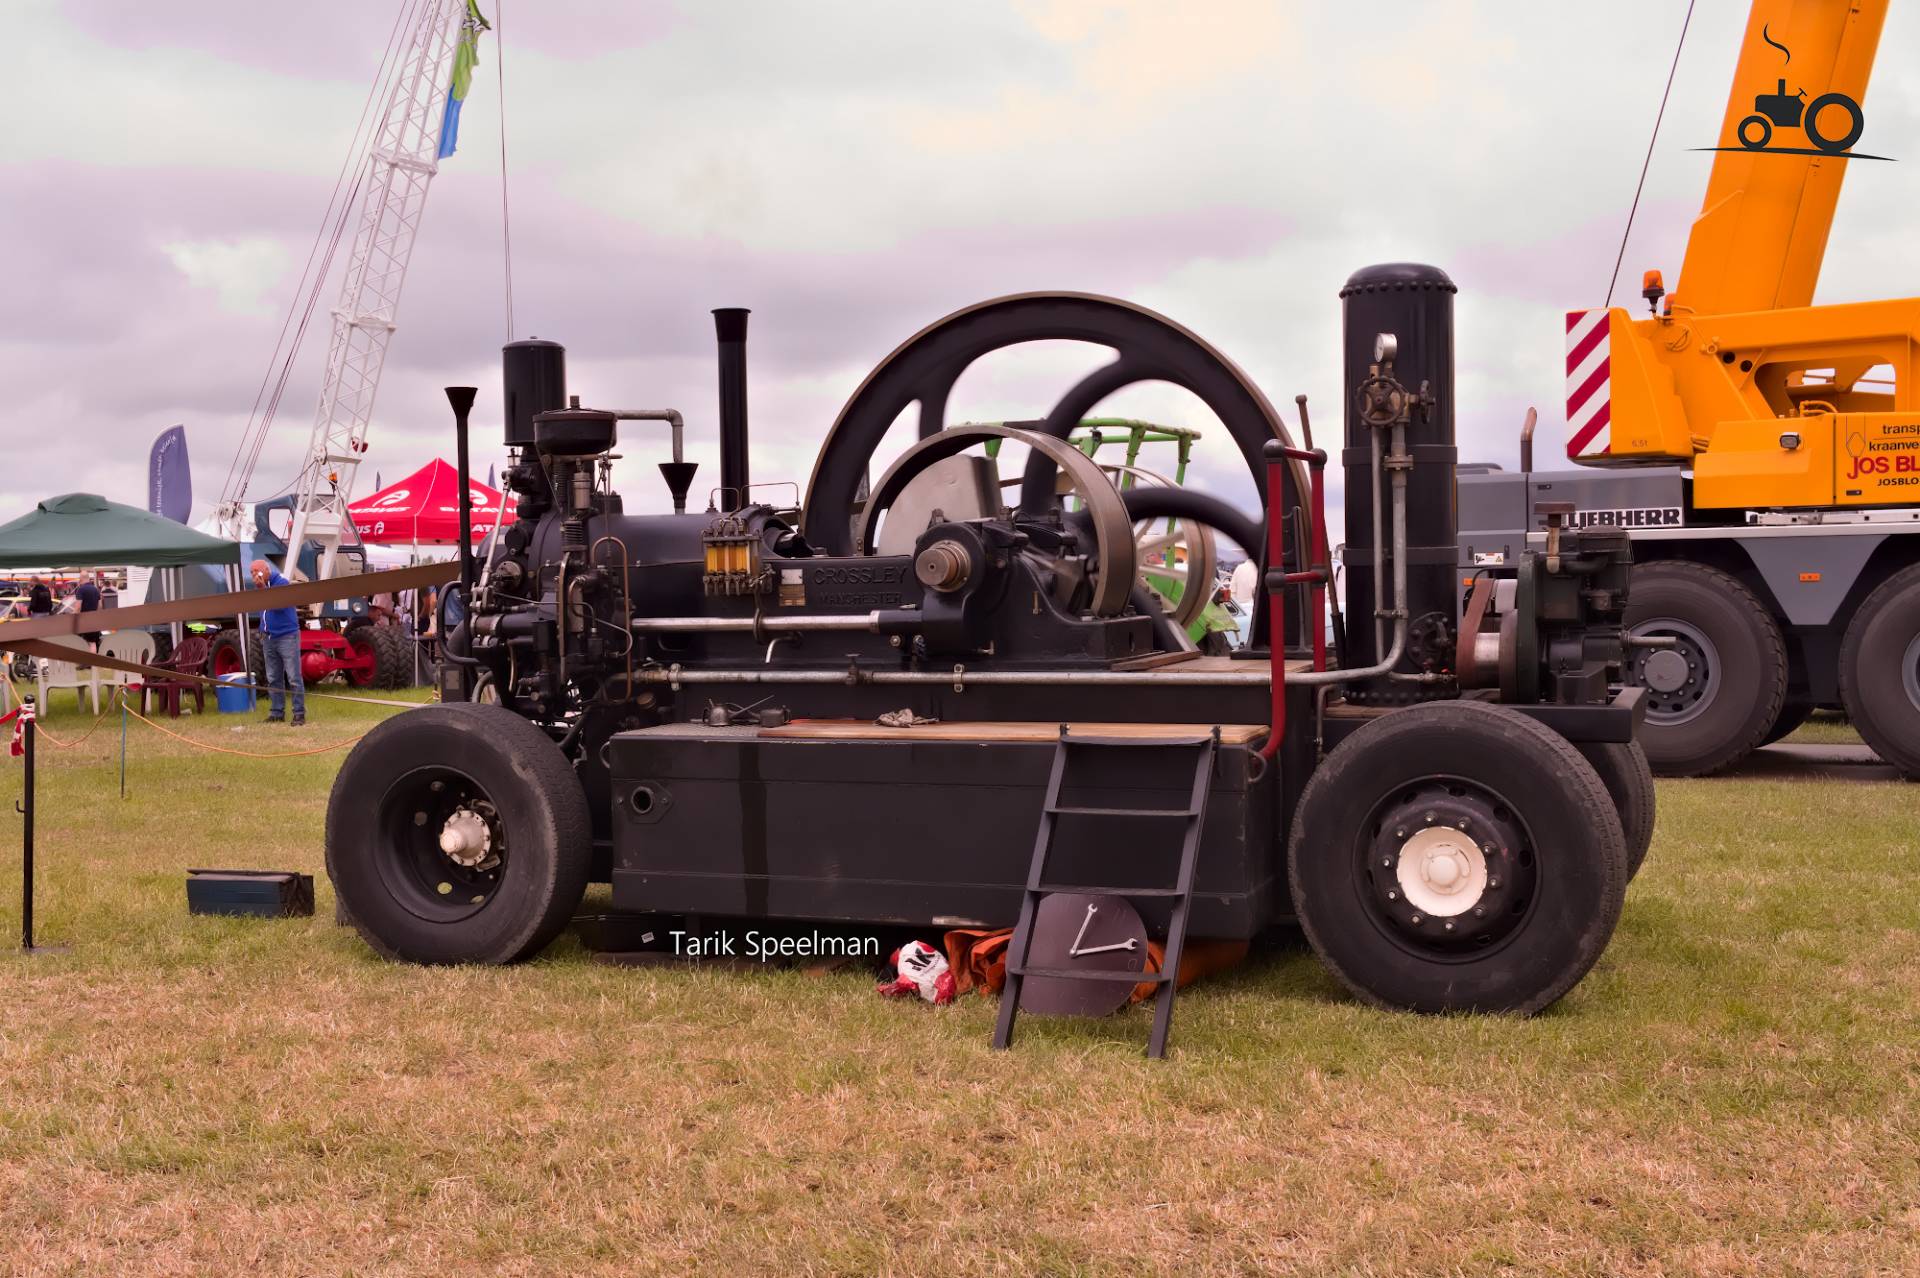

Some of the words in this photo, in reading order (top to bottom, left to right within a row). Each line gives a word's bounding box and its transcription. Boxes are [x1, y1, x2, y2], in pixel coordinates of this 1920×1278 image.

[1847, 456, 1890, 479] JOS
[1896, 455, 1920, 473] BL
[1568, 509, 1680, 530] LIEBHERR
[814, 567, 908, 585] CROSSLEY
